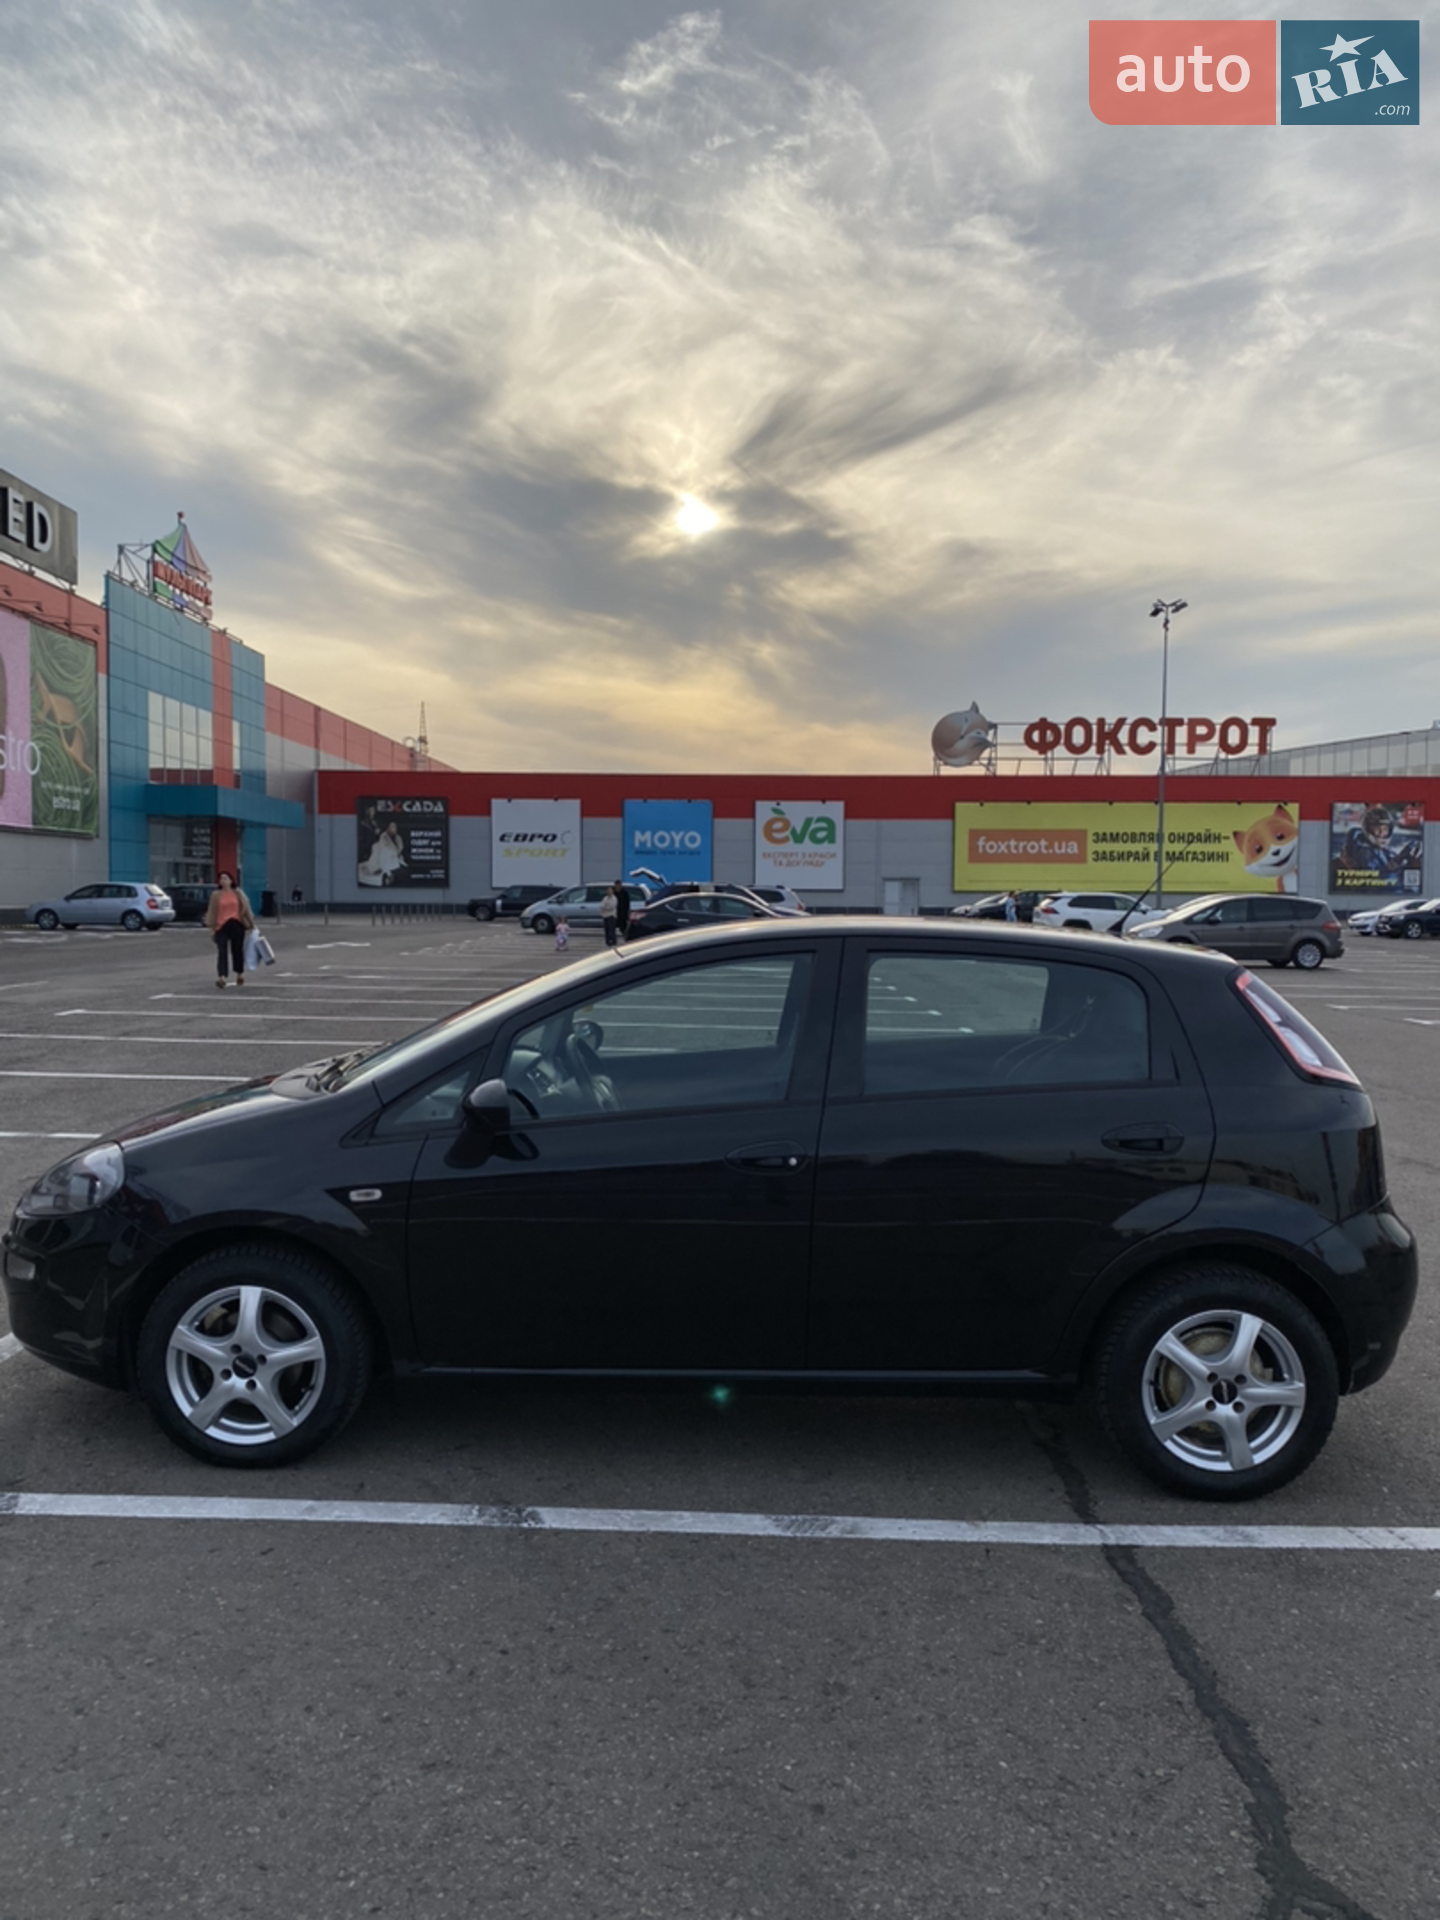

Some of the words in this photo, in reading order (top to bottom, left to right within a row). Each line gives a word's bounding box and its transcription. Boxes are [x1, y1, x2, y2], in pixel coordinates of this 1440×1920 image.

[1023, 716, 1277, 756] ФОКСТРОТ
[634, 830, 702, 849] MOYO
[977, 836, 1079, 855] foxtrot.ua
[1092, 847, 1150, 862] ЗАБИРАЙ
